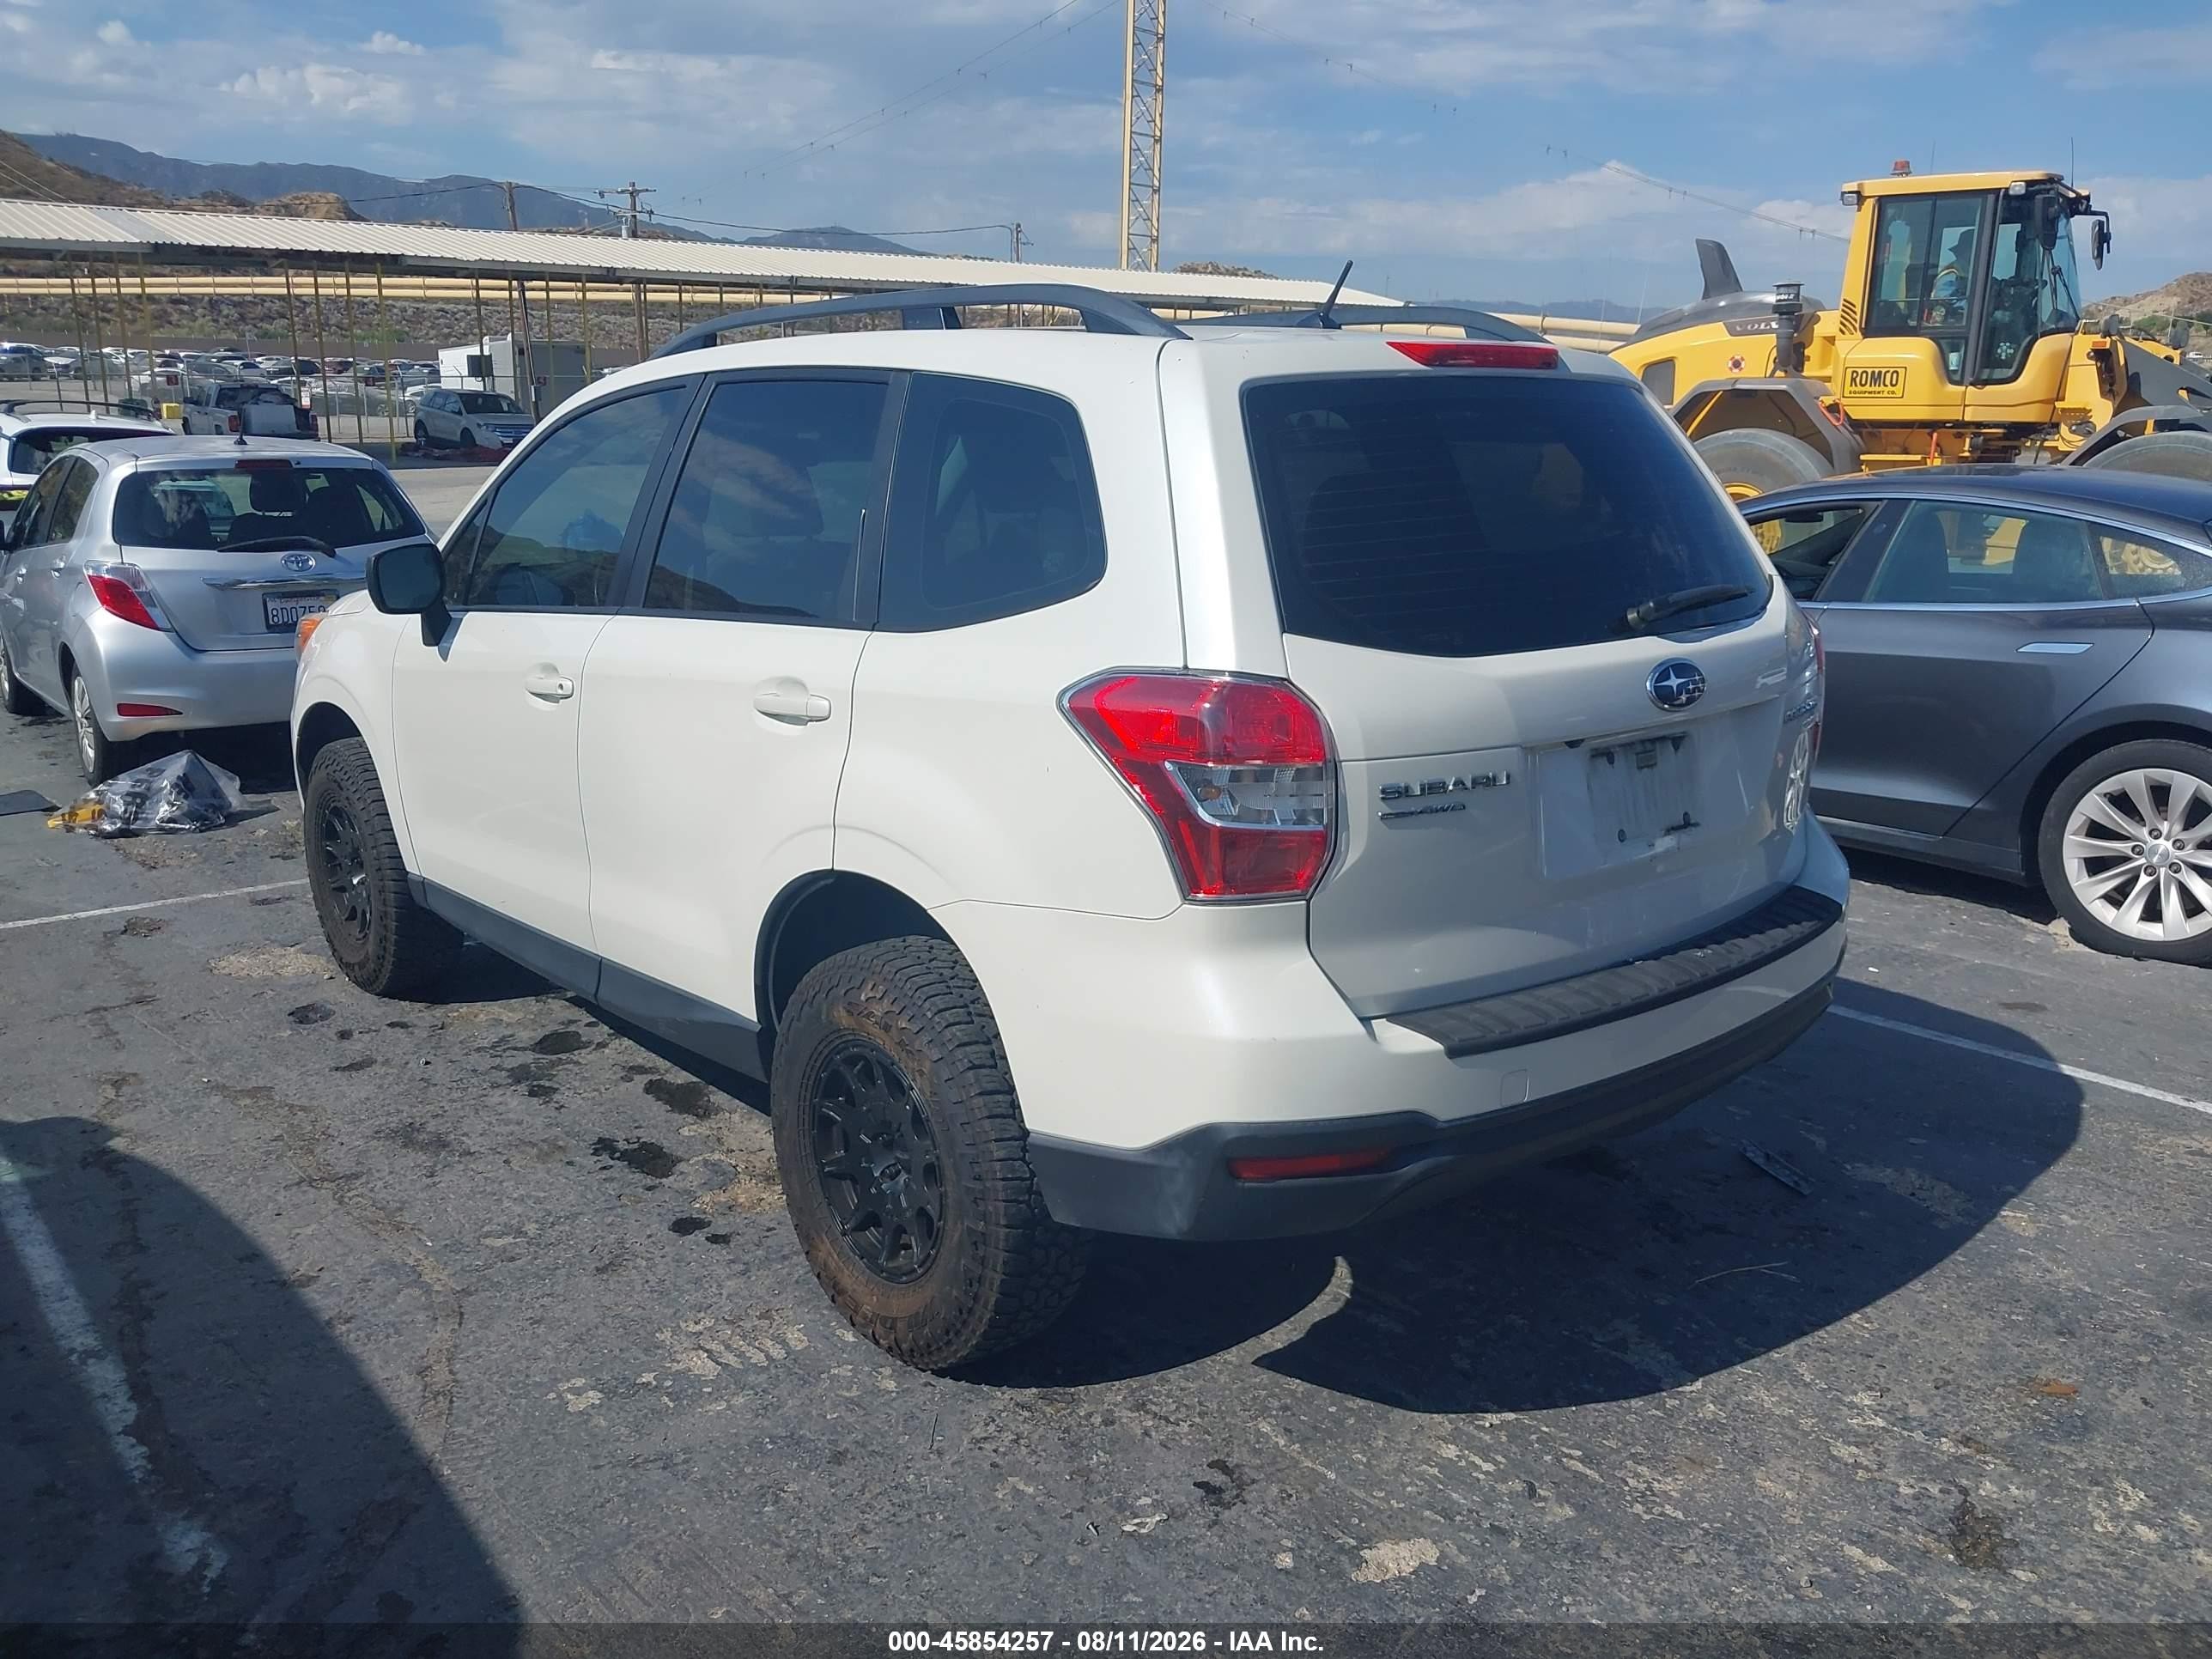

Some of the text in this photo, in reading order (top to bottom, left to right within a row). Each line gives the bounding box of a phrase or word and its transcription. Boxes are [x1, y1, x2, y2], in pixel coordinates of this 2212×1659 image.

[1735, 321, 1779, 331] VOLV
[1849, 369, 1899, 387] ROMCO
[1379, 770, 1511, 799] SUBARU
